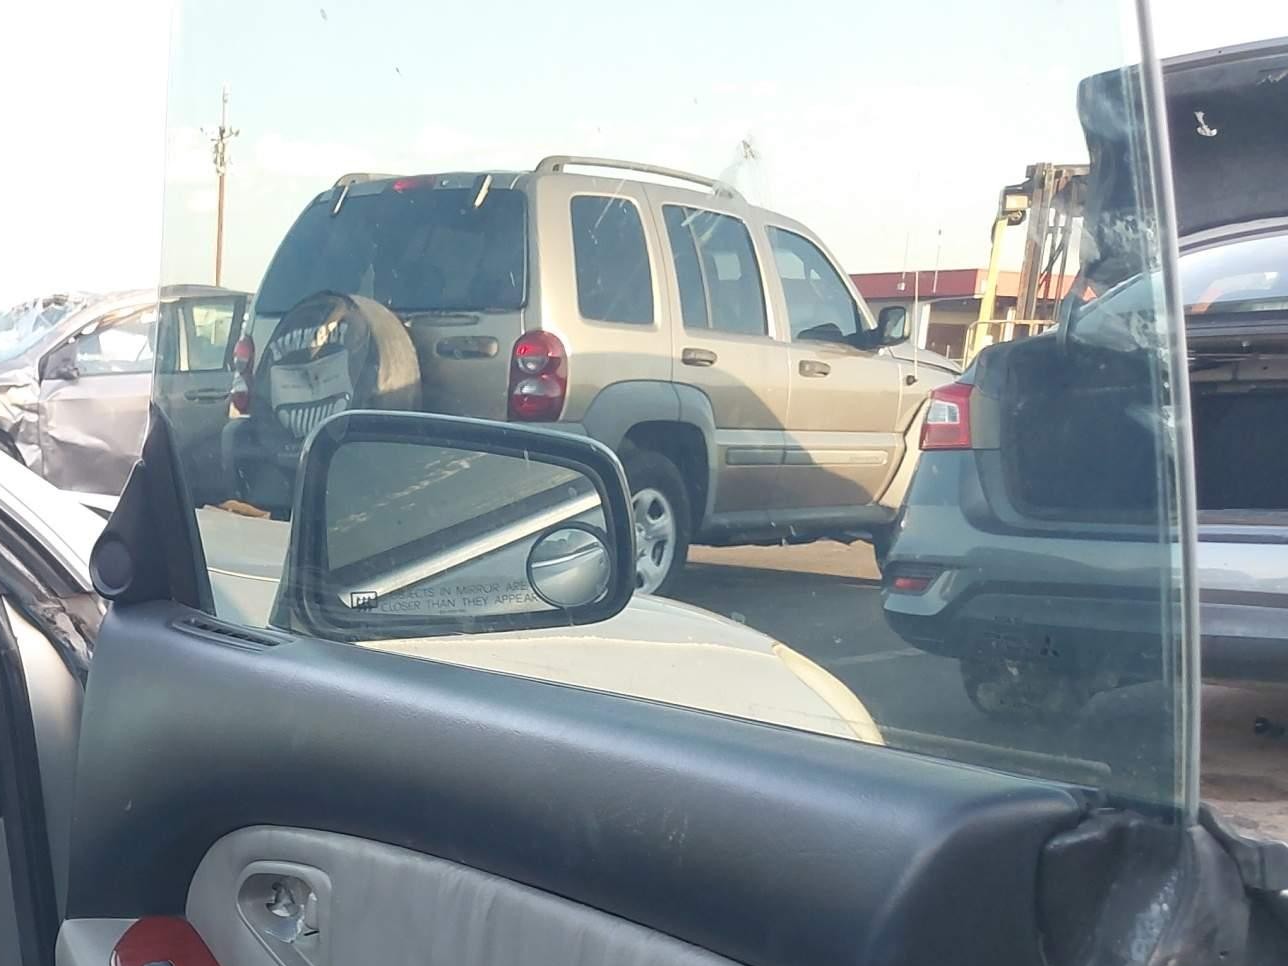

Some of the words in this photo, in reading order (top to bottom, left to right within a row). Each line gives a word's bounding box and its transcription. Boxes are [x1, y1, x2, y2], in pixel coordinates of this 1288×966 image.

[386, 587, 434, 600] JECTS
[439, 586, 451, 596] IN
[506, 581, 529, 592] ARE
[380, 600, 420, 612] CLOSER
[427, 599, 455, 609] THAN
[463, 596, 488, 607] THEY
[494, 592, 539, 605] APPEAR
